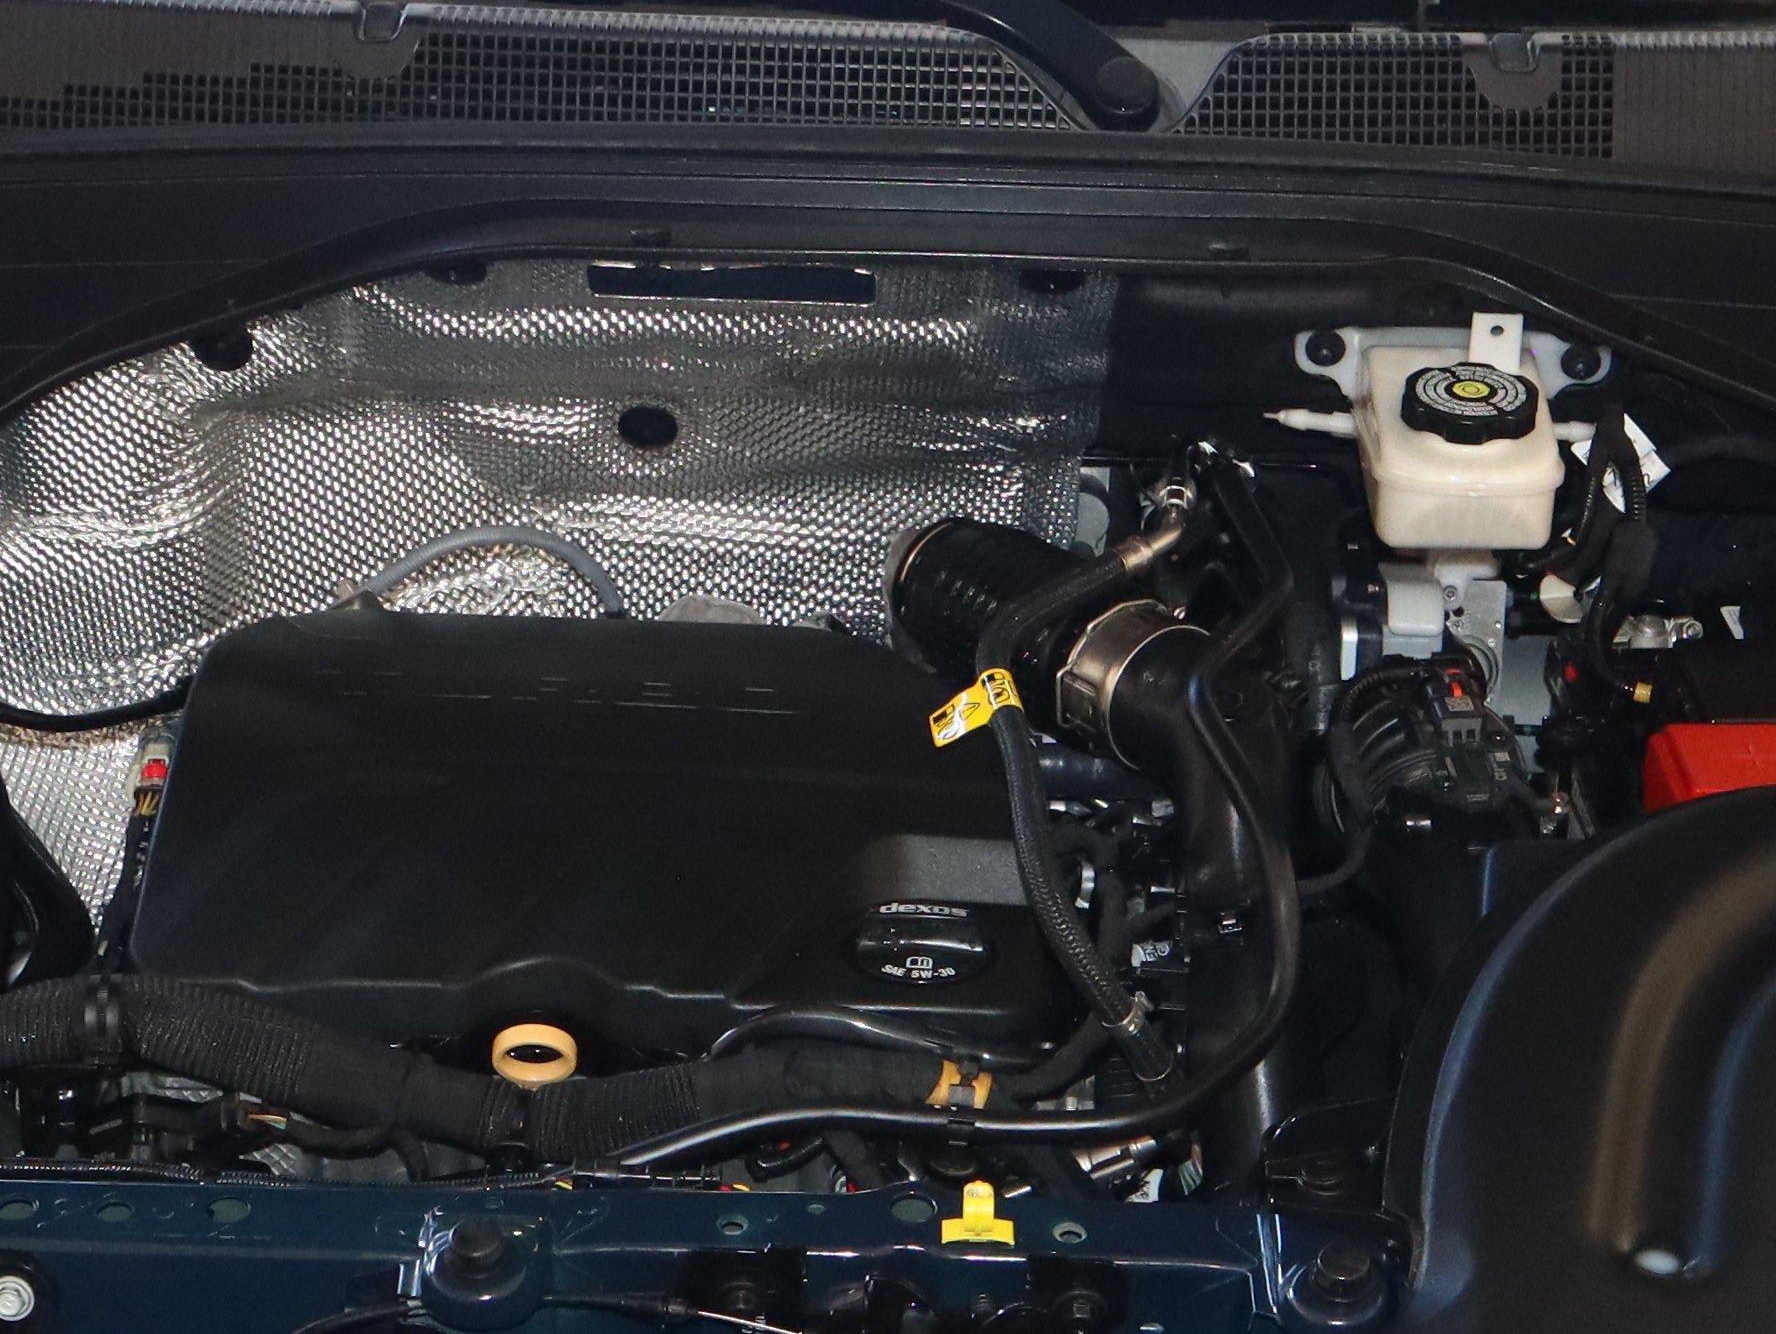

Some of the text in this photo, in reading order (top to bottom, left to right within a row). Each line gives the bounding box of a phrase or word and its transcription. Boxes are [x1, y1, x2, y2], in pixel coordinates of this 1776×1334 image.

[879, 903, 968, 917] dexos
[881, 964, 956, 978] SAE 5W-30
